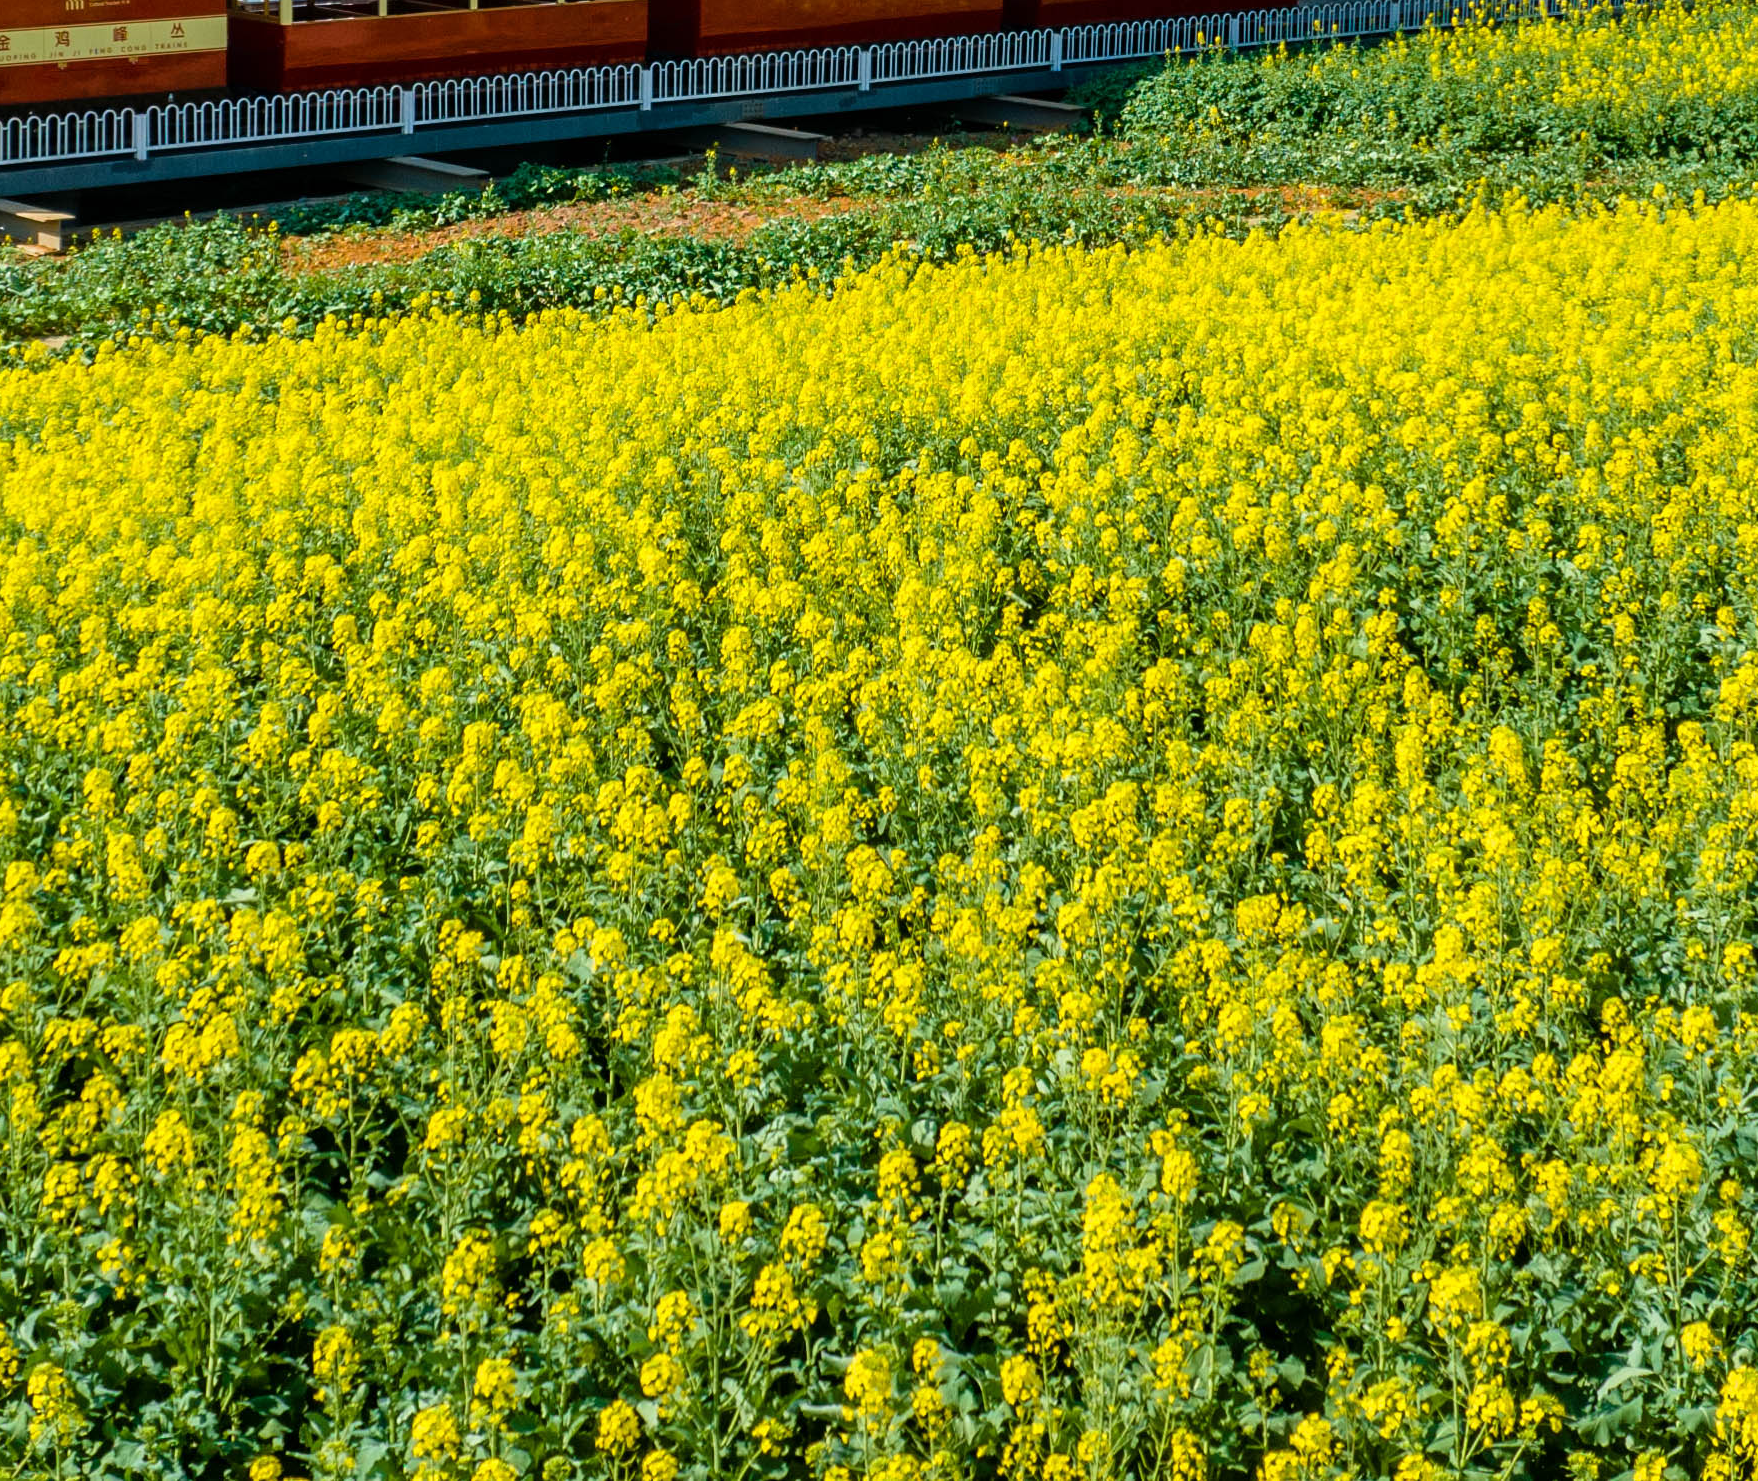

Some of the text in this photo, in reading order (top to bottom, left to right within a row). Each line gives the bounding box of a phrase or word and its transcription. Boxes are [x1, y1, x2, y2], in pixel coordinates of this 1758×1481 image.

[50, 50, 64, 58] JIN
[89, 46, 113, 55] FENG
[121, 44, 147, 53] CONG
[155, 41, 188, 50] TRAINS
